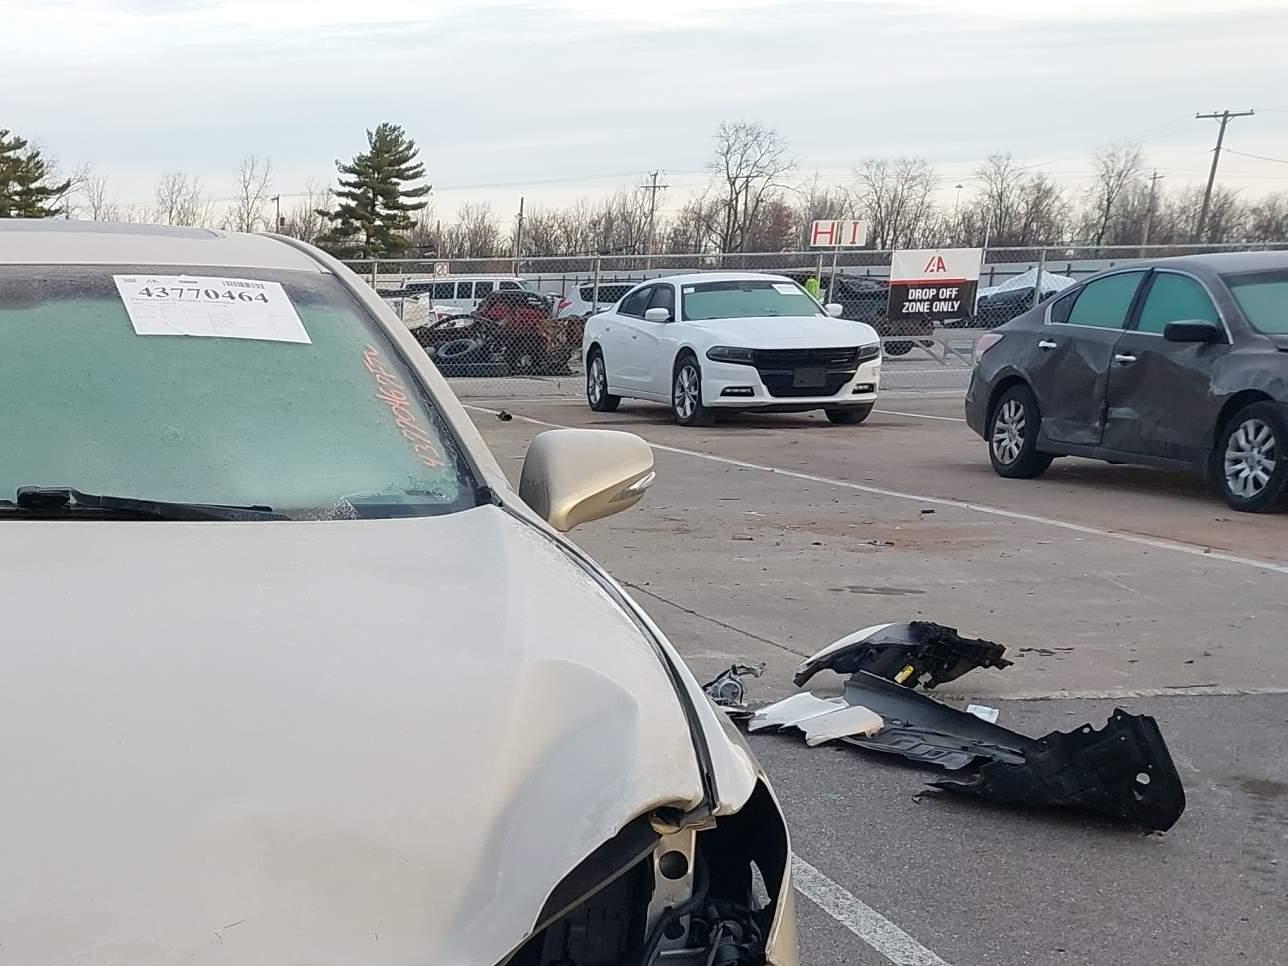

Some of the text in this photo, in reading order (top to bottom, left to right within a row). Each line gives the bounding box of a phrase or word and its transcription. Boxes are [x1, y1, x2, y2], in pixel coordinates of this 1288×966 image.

[813, 222, 858, 245] H I
[137, 286, 269, 304] 43770464
[908, 288, 958, 300] DROP OFF
[902, 301, 961, 313] ZONE ONLY
